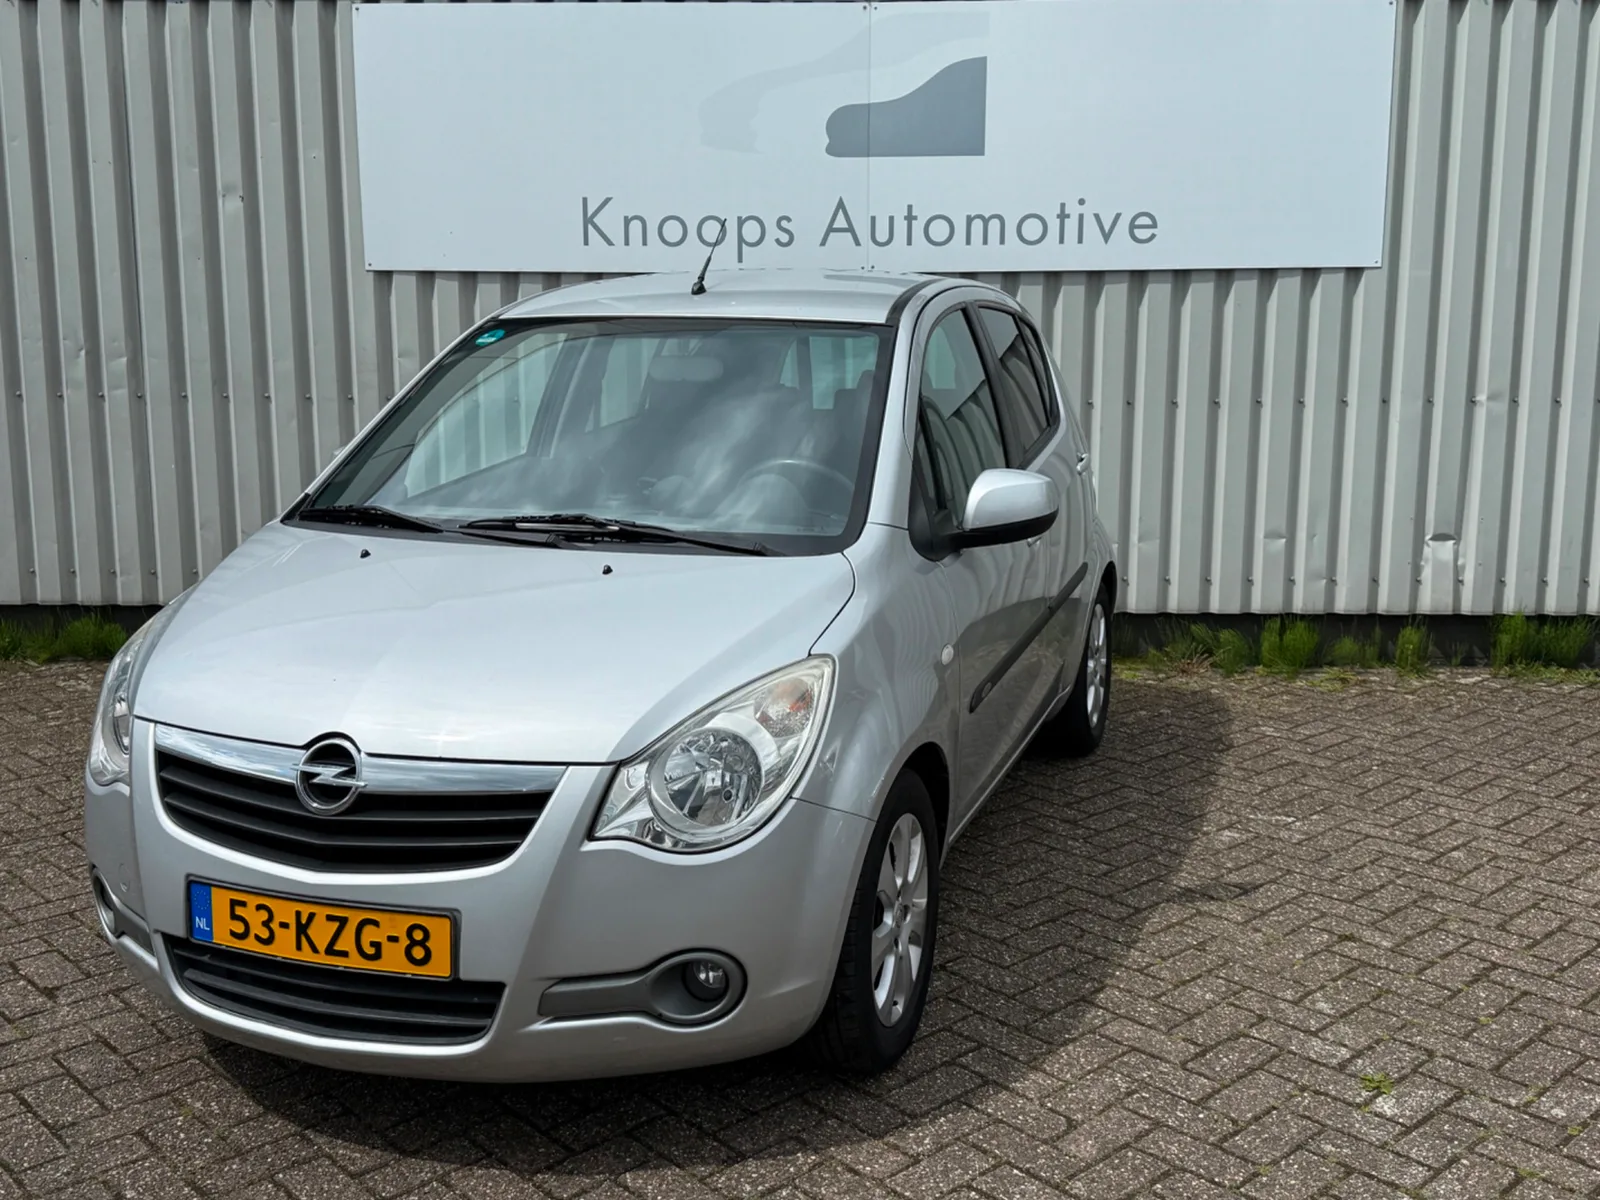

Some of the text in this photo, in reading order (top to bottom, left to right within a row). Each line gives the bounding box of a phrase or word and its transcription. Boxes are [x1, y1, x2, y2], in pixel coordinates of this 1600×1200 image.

[582, 196, 1158, 263] Knoops Automotive
[195, 916, 210, 931] NL
[228, 898, 432, 967] 53-KZG-8
